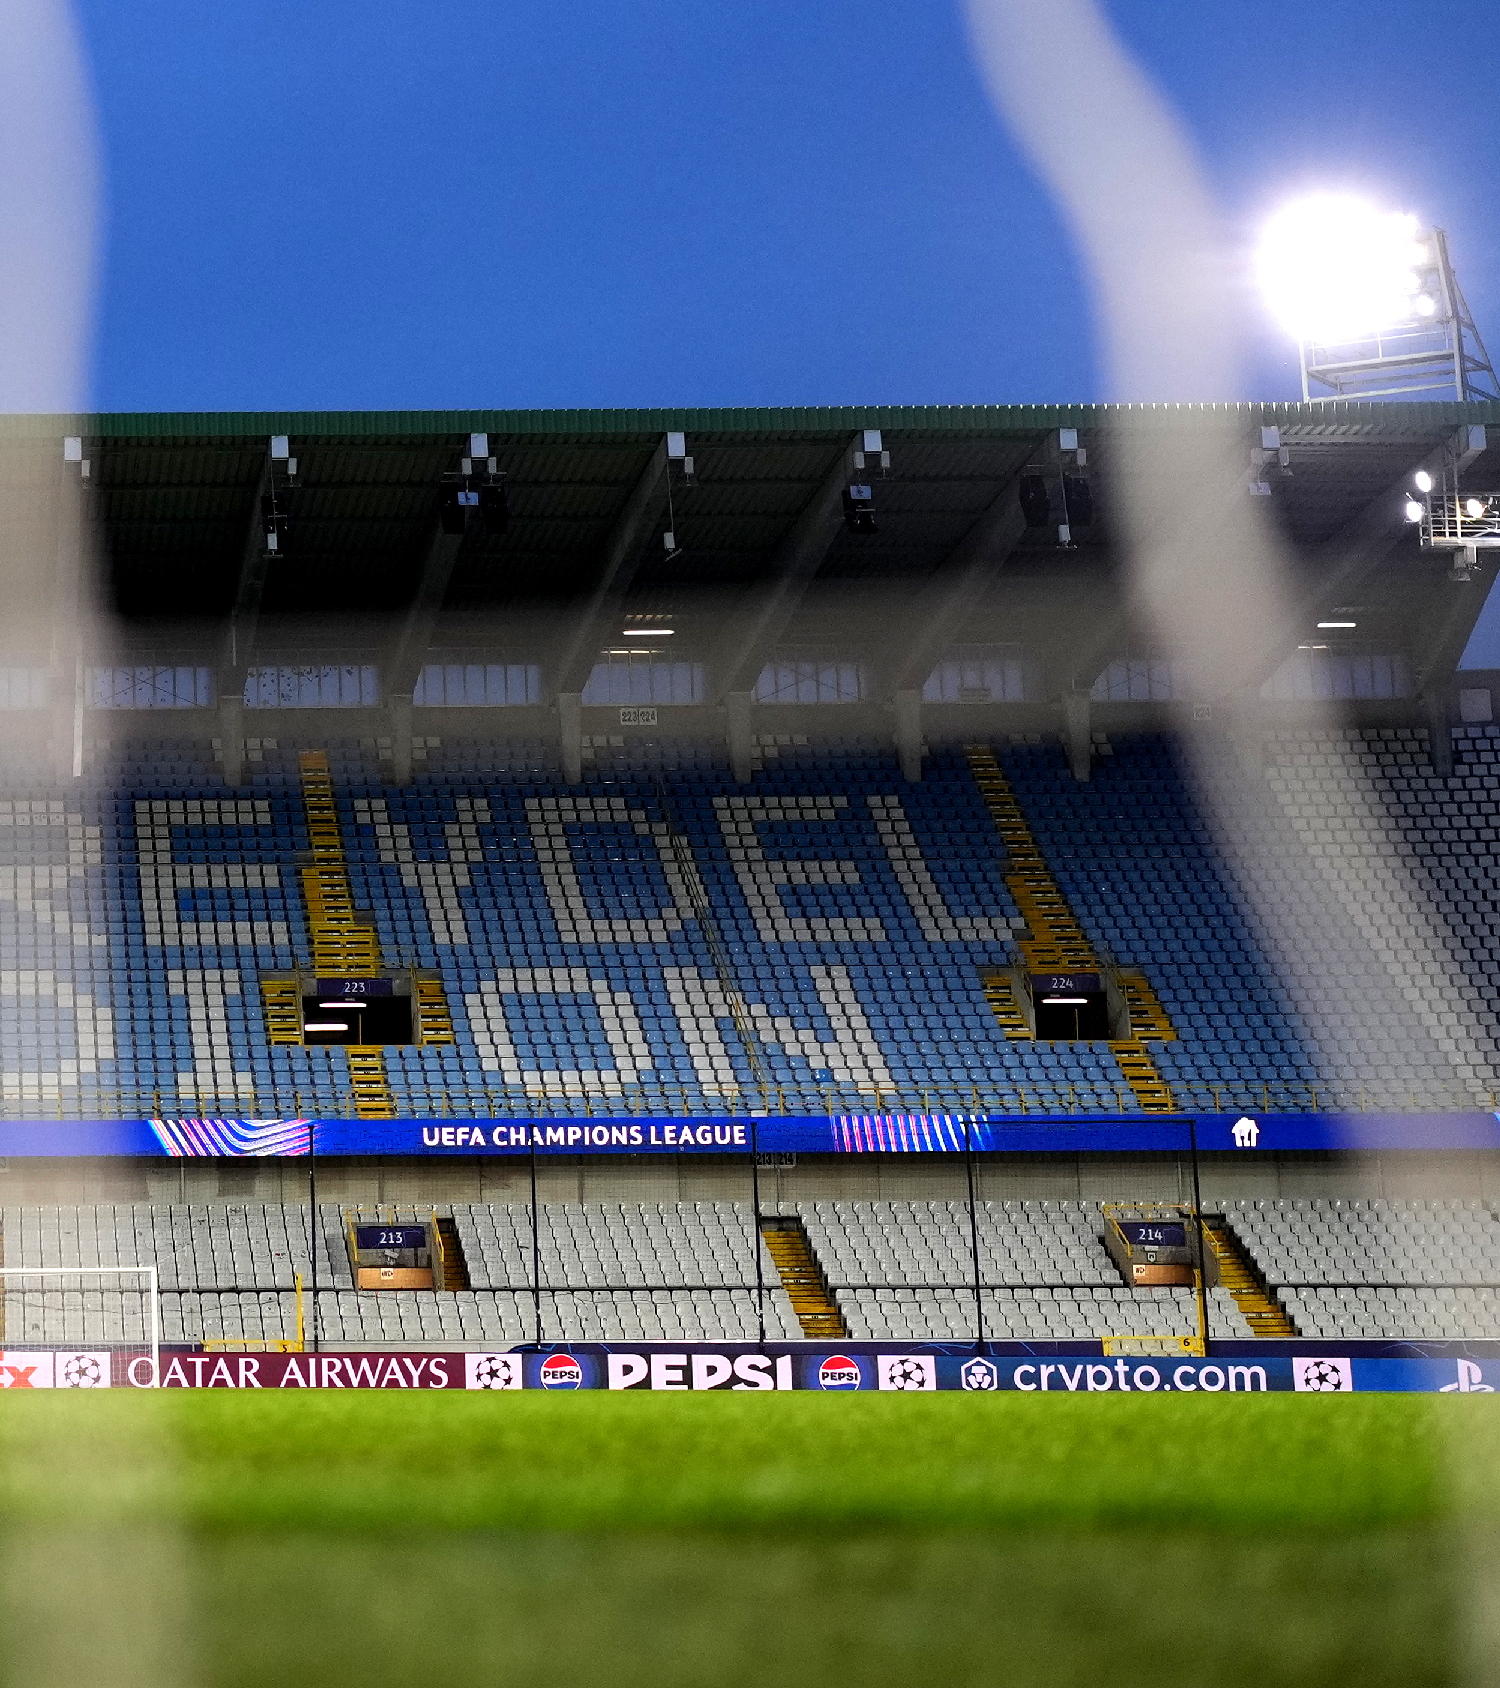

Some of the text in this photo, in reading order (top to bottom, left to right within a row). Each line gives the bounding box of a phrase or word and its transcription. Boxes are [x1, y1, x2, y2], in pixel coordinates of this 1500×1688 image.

[343, 981, 366, 993] 223
[1051, 977, 1074, 989] 224
[422, 1125, 747, 1147] UEFA CHAMPIONS LEAGUE
[379, 1231, 403, 1244] 213
[1138, 1228, 1163, 1241] 214
[127, 1357, 449, 1388] QATAR AIRWAYS
[542, 1370, 580, 1380] PEPSI
[607, 1353, 793, 1391] PEPSI
[821, 1371, 859, 1382] PEPSI
[1012, 1358, 1268, 1392] crypto.com
